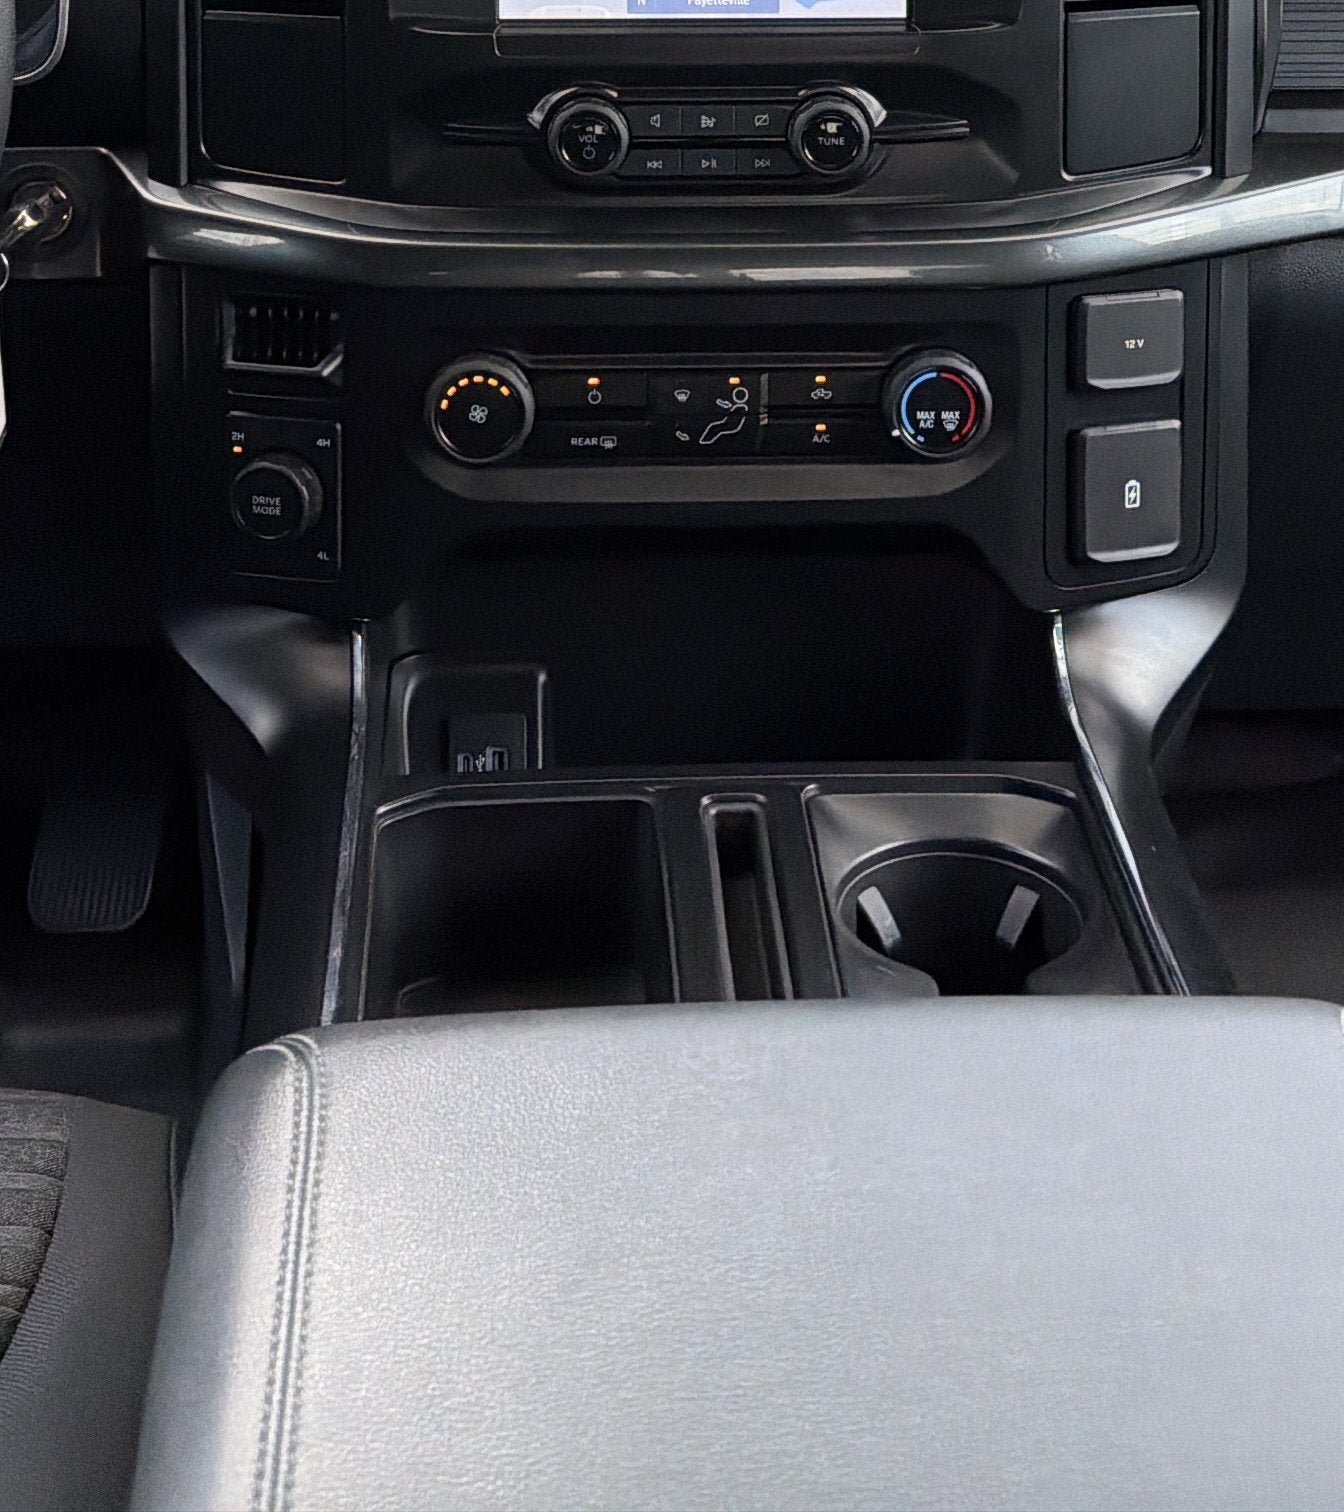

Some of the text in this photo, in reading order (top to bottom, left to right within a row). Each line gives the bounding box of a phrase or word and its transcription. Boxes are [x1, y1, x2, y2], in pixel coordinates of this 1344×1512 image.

[578, 135, 597, 144] VOL
[817, 136, 845, 146] TUNE
[916, 410, 936, 420] MAX
[941, 410, 960, 420] MAX
[918, 420, 934, 430] A/C
[232, 432, 244, 440] 2H
[812, 434, 831, 444] A/C
[316, 438, 331, 448] 4H
[570, 437, 598, 447] REAR
[252, 495, 281, 506] DRIVE
[252, 506, 282, 516] MODE
[316, 551, 330, 560] 4L
